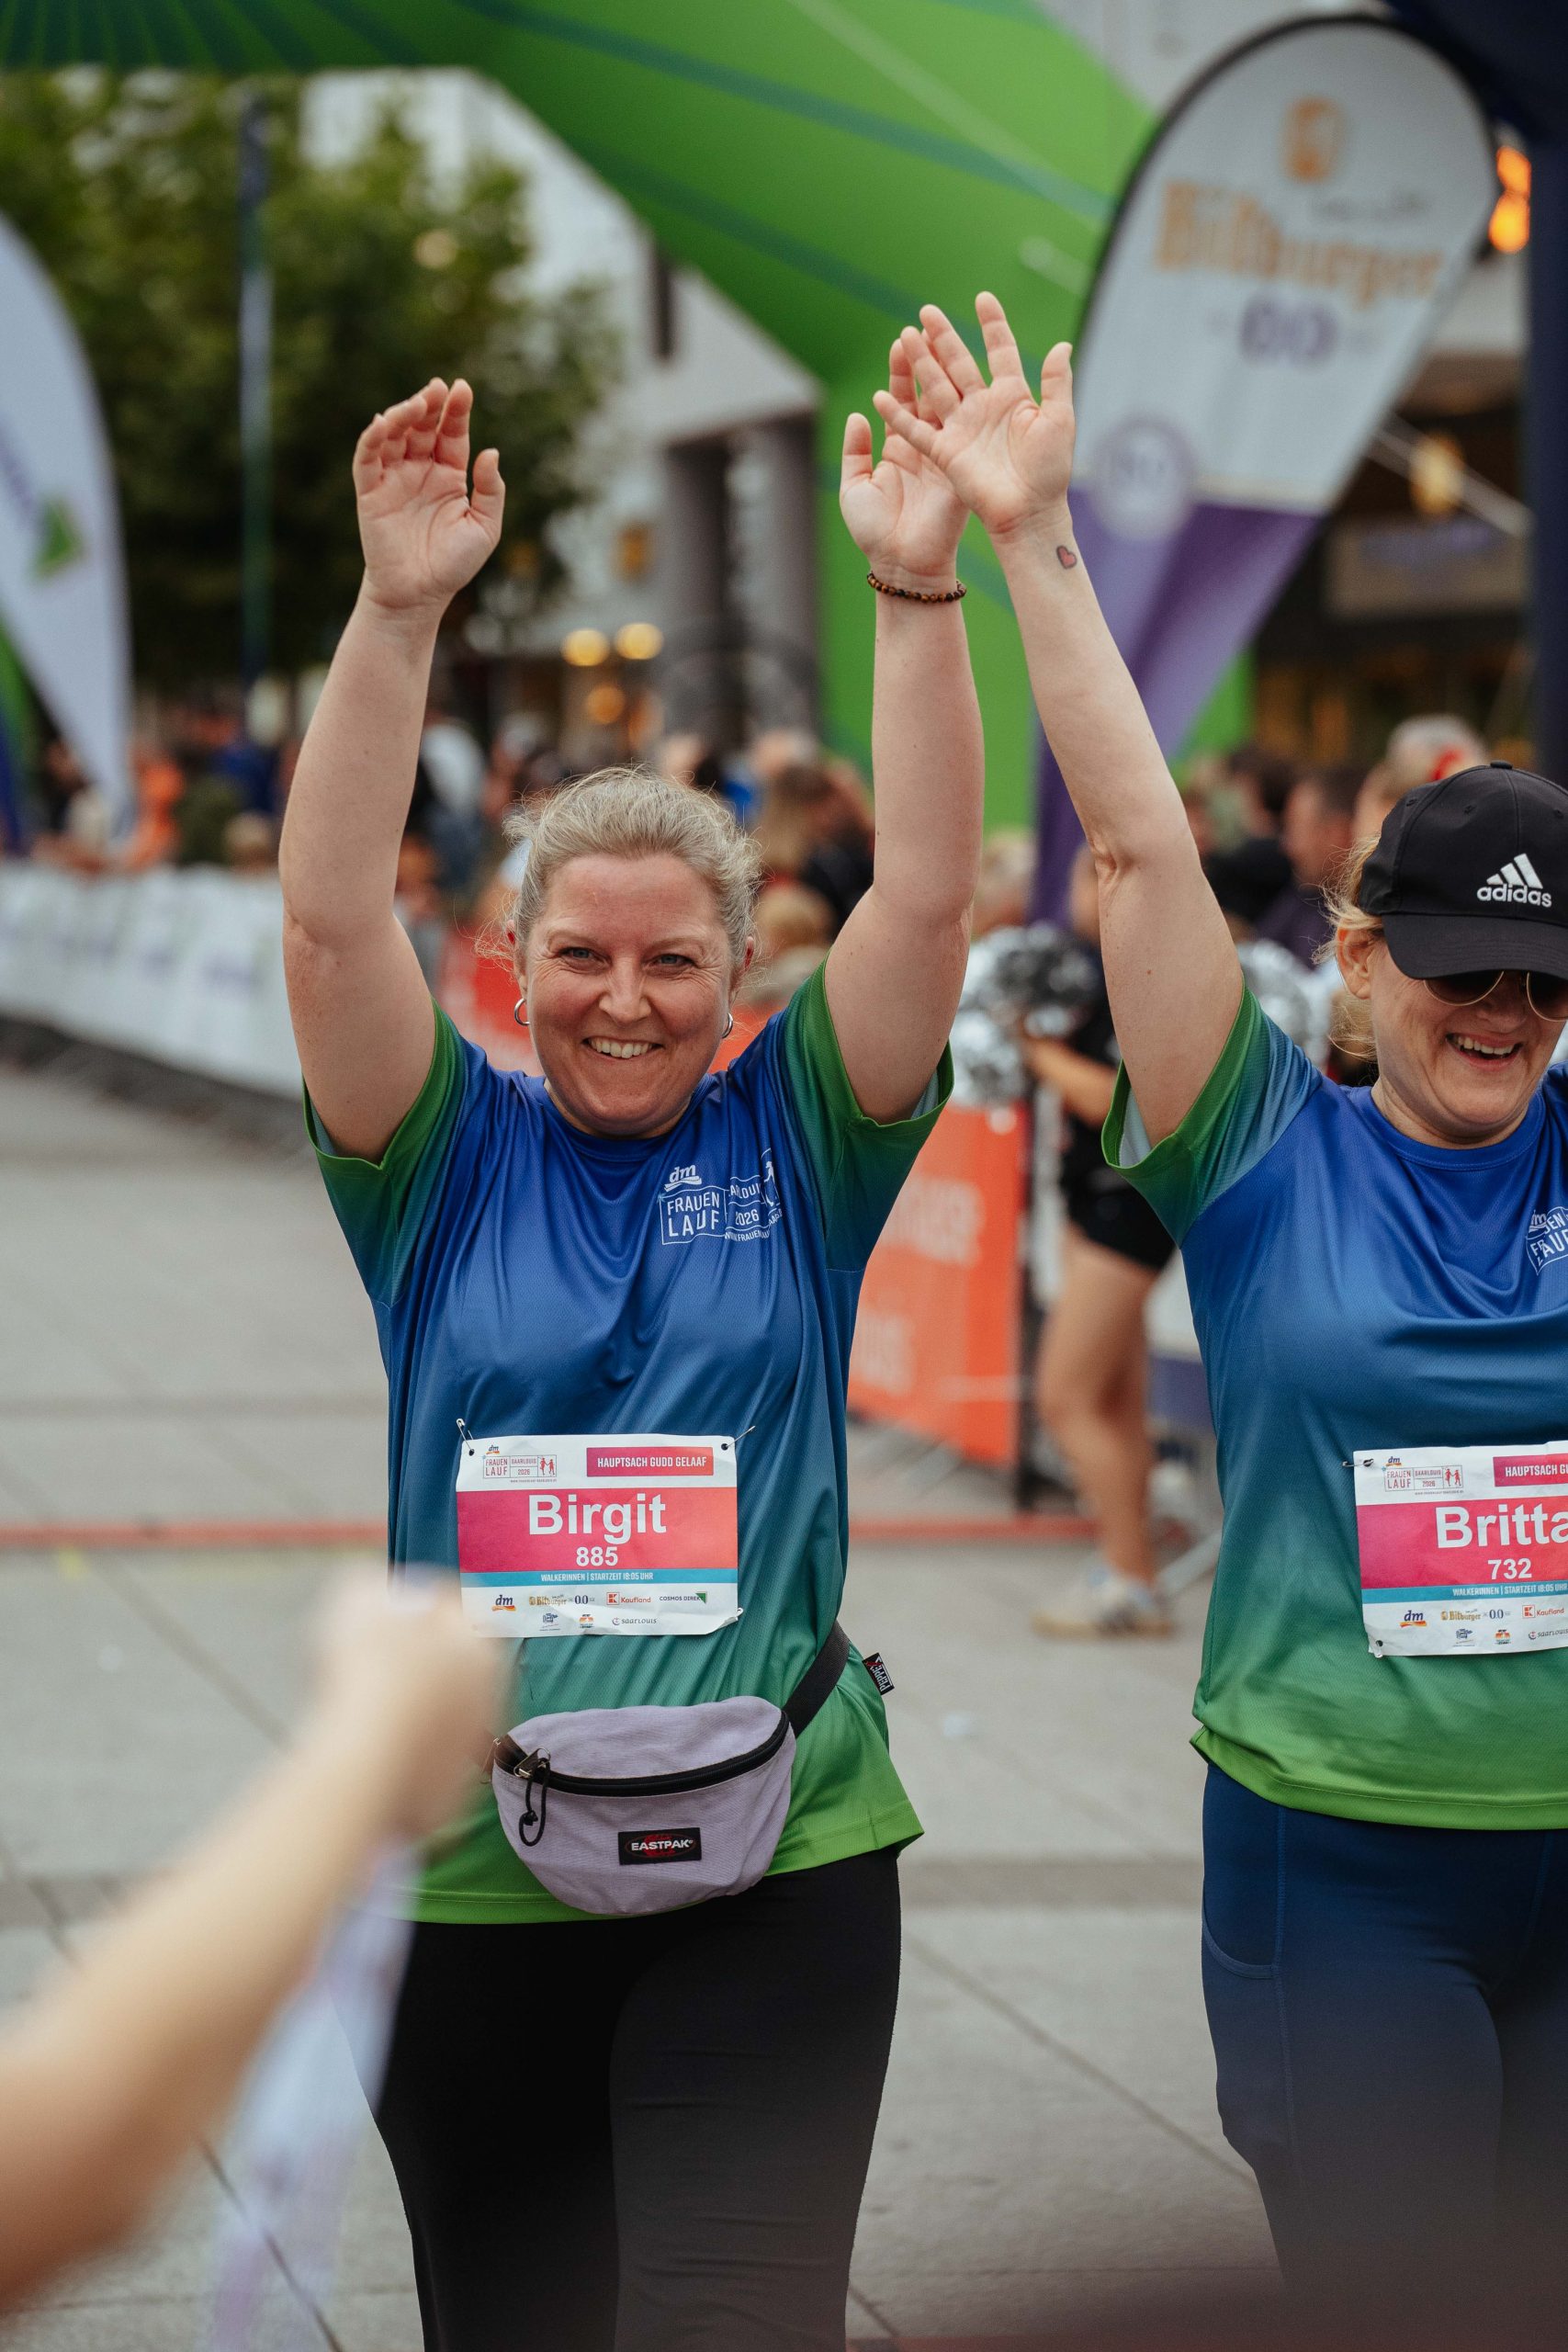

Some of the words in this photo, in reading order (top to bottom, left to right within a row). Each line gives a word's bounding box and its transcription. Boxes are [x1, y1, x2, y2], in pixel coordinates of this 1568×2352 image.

[1476, 883, 1552, 908] adidas
[669, 1164, 696, 1183] dm
[667, 1192, 720, 1216] FRAUEN
[668, 1209, 720, 1238] LAUF
[488, 1444, 500, 1453] dm
[485, 1458, 508, 1467] FRAUEN
[511, 1456, 537, 1464] SAARLOUIS
[597, 1457, 648, 1468] HAUPTSACH
[649, 1456, 673, 1467] GUDD
[675, 1456, 707, 1467] GELAAF
[1387, 1456, 1401, 1464] dm
[485, 1467, 508, 1476] LAUF
[1386, 1470, 1411, 1478] FRAUEN
[1505, 1464, 1558, 1477] HAUPTSACH
[1387, 1479, 1412, 1489] LAUF
[1422, 1479, 1436, 1487] 2026
[528, 1493, 667, 1545] Birgit
[1436, 1503, 1568, 1549] Britta
[576, 1546, 618, 1566] 885
[1487, 1557, 1532, 1580] 732
[540, 1573, 586, 1582] WALKERINNEN
[590, 1572, 622, 1581] STARTZEIT
[623, 1572, 638, 1580] 18:05
[639, 1572, 654, 1580] UHR
[1452, 1587, 1500, 1597] WALKERINNEN
[1504, 1585, 1537, 1594] STARTZEIT
[1538, 1583, 1554, 1593] 18:05
[1554, 1582, 1568, 1592] UHR
[495, 1594, 513, 1606] dm
[536, 1595, 568, 1607] Bitburger
[620, 1596, 651, 1604] Kaufland
[1404, 1610, 1424, 1622] dm
[1449, 1610, 1482, 1622] Bitburger
[1536, 1607, 1565, 1617] Kaufland
[631, 1838, 690, 1851] EASTPAK
